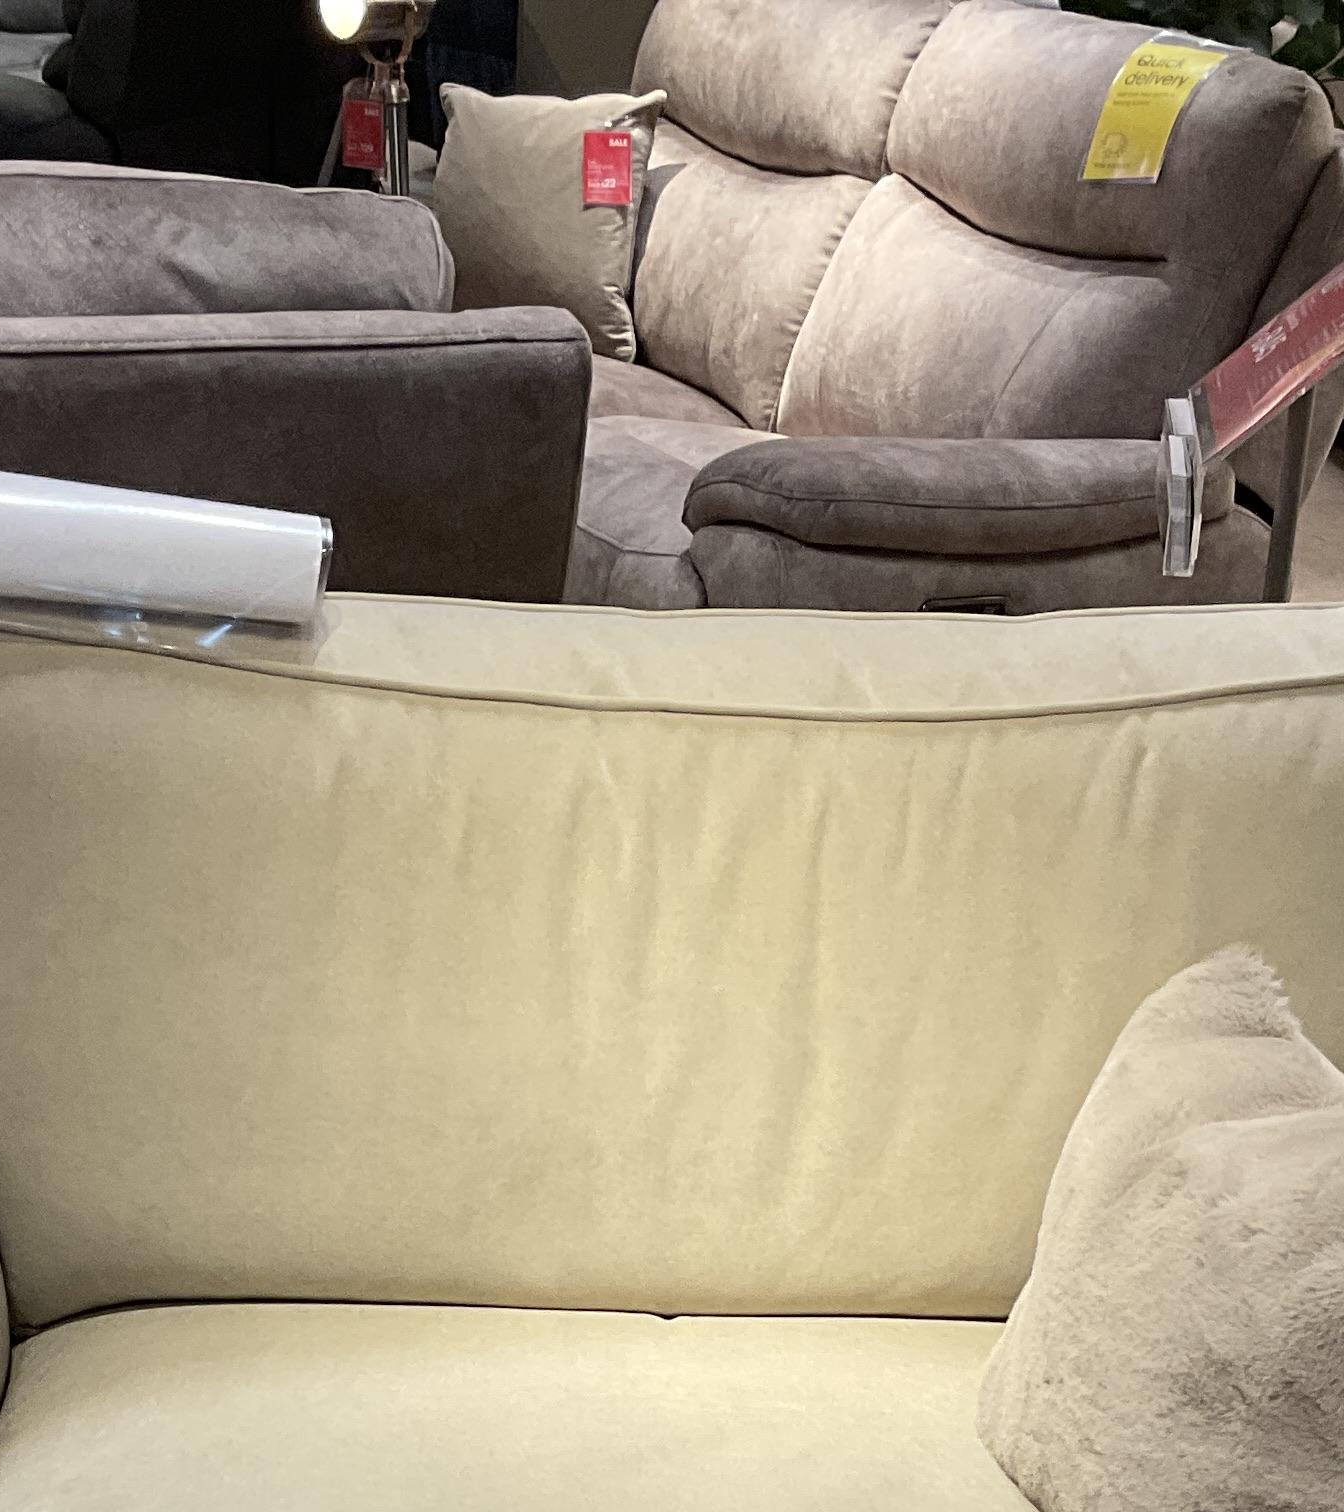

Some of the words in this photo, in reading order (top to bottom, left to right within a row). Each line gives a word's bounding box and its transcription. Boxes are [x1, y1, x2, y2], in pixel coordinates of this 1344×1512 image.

[1137, 54, 1186, 69] Quick
[1124, 71, 1190, 89] delivery
[609, 138, 628, 147] SALE
